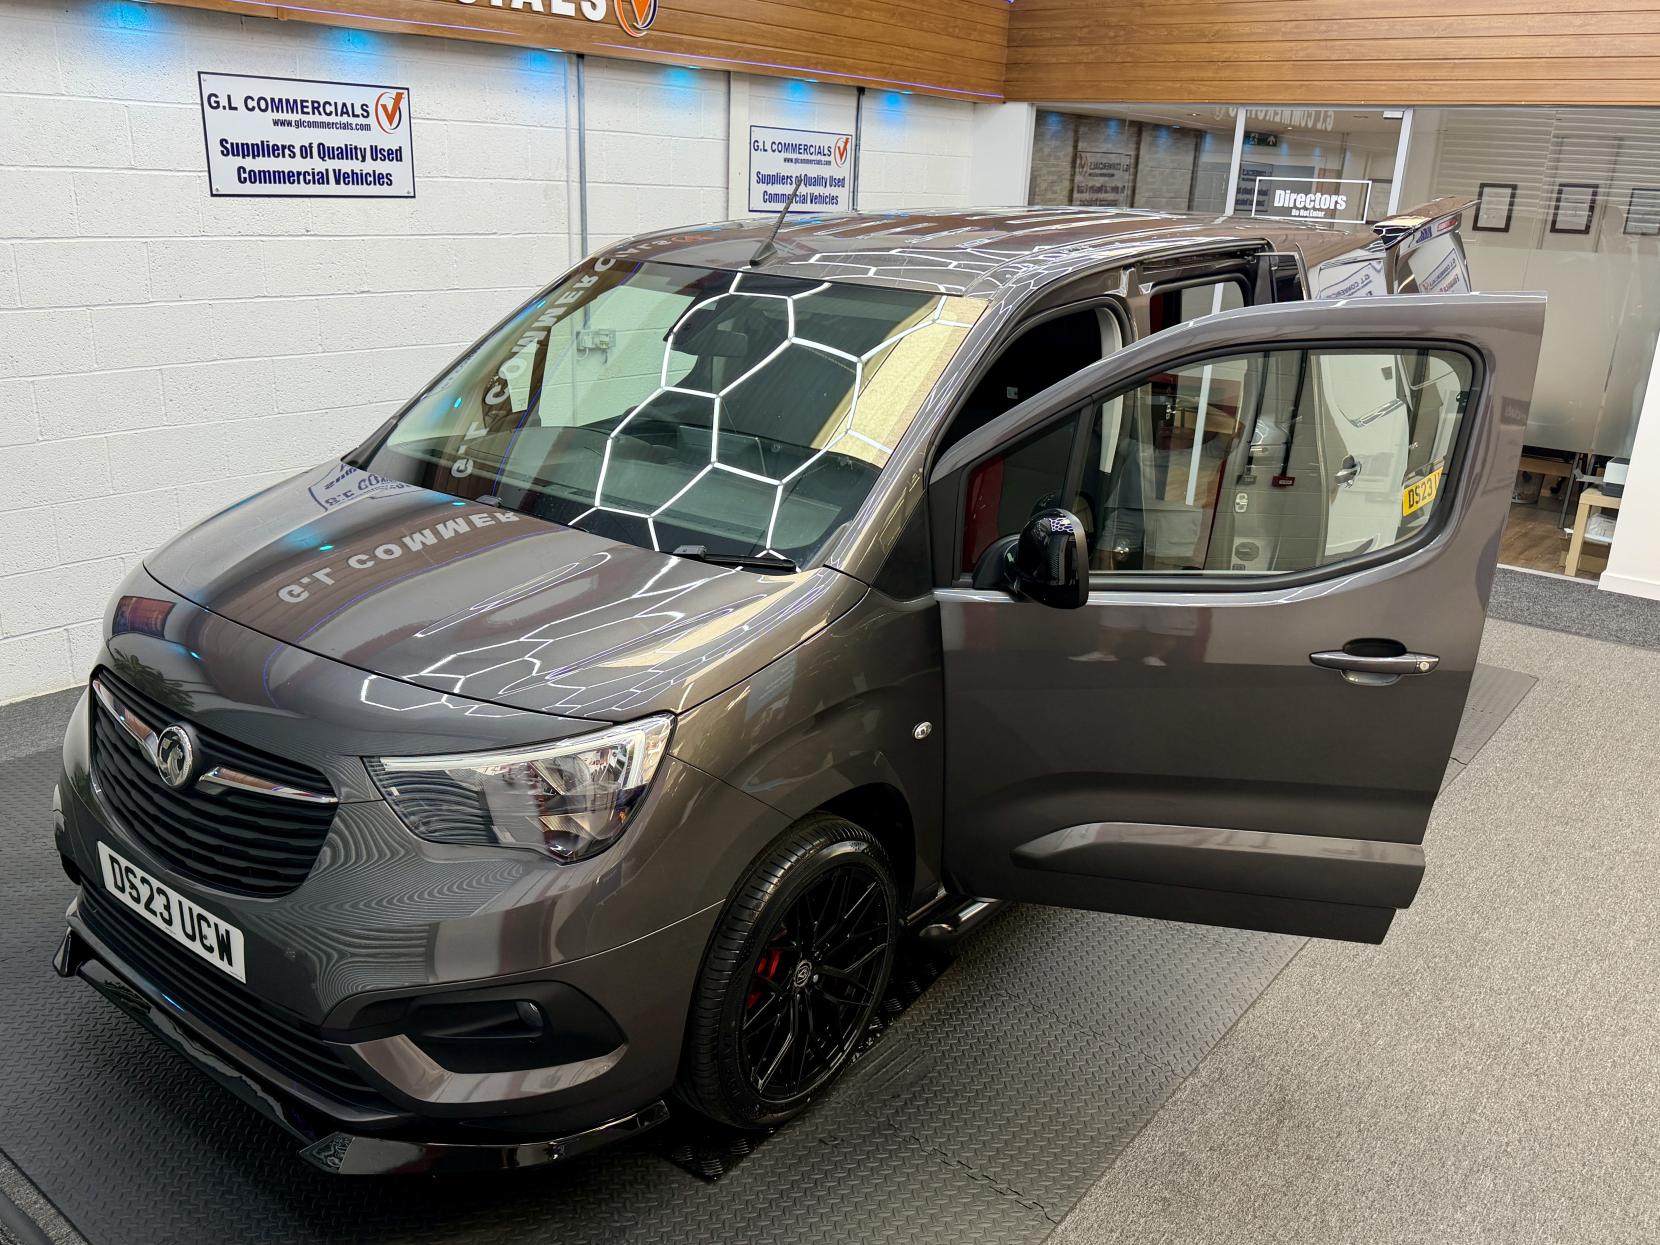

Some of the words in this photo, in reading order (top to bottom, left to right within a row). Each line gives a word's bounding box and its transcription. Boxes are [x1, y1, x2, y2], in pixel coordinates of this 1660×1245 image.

[207, 93, 238, 111] G.L
[244, 95, 371, 118] COMMERCIALS
[272, 118, 372, 132] www.glcommercials.com
[219, 138, 296, 160] Suppliers
[300, 142, 314, 159] of
[317, 142, 367, 163] Quality
[370, 145, 403, 162] Used
[753, 139, 768, 152] G.L
[770, 141, 832, 157] COMMERCIALS
[236, 165, 329, 185] Commercial
[332, 168, 393, 186] Vehicles
[756, 171, 793, 186] Suppliers
[803, 174, 828, 189] Quality
[829, 175, 846, 188] Used
[809, 192, 839, 206] Vehicles
[1273, 189, 1347, 210] Directors
[1291, 208, 1299, 216] Do
[1300, 209, 1309, 217] Not
[1408, 477, 1433, 509] DS23
[108, 853, 173, 927] DS23
